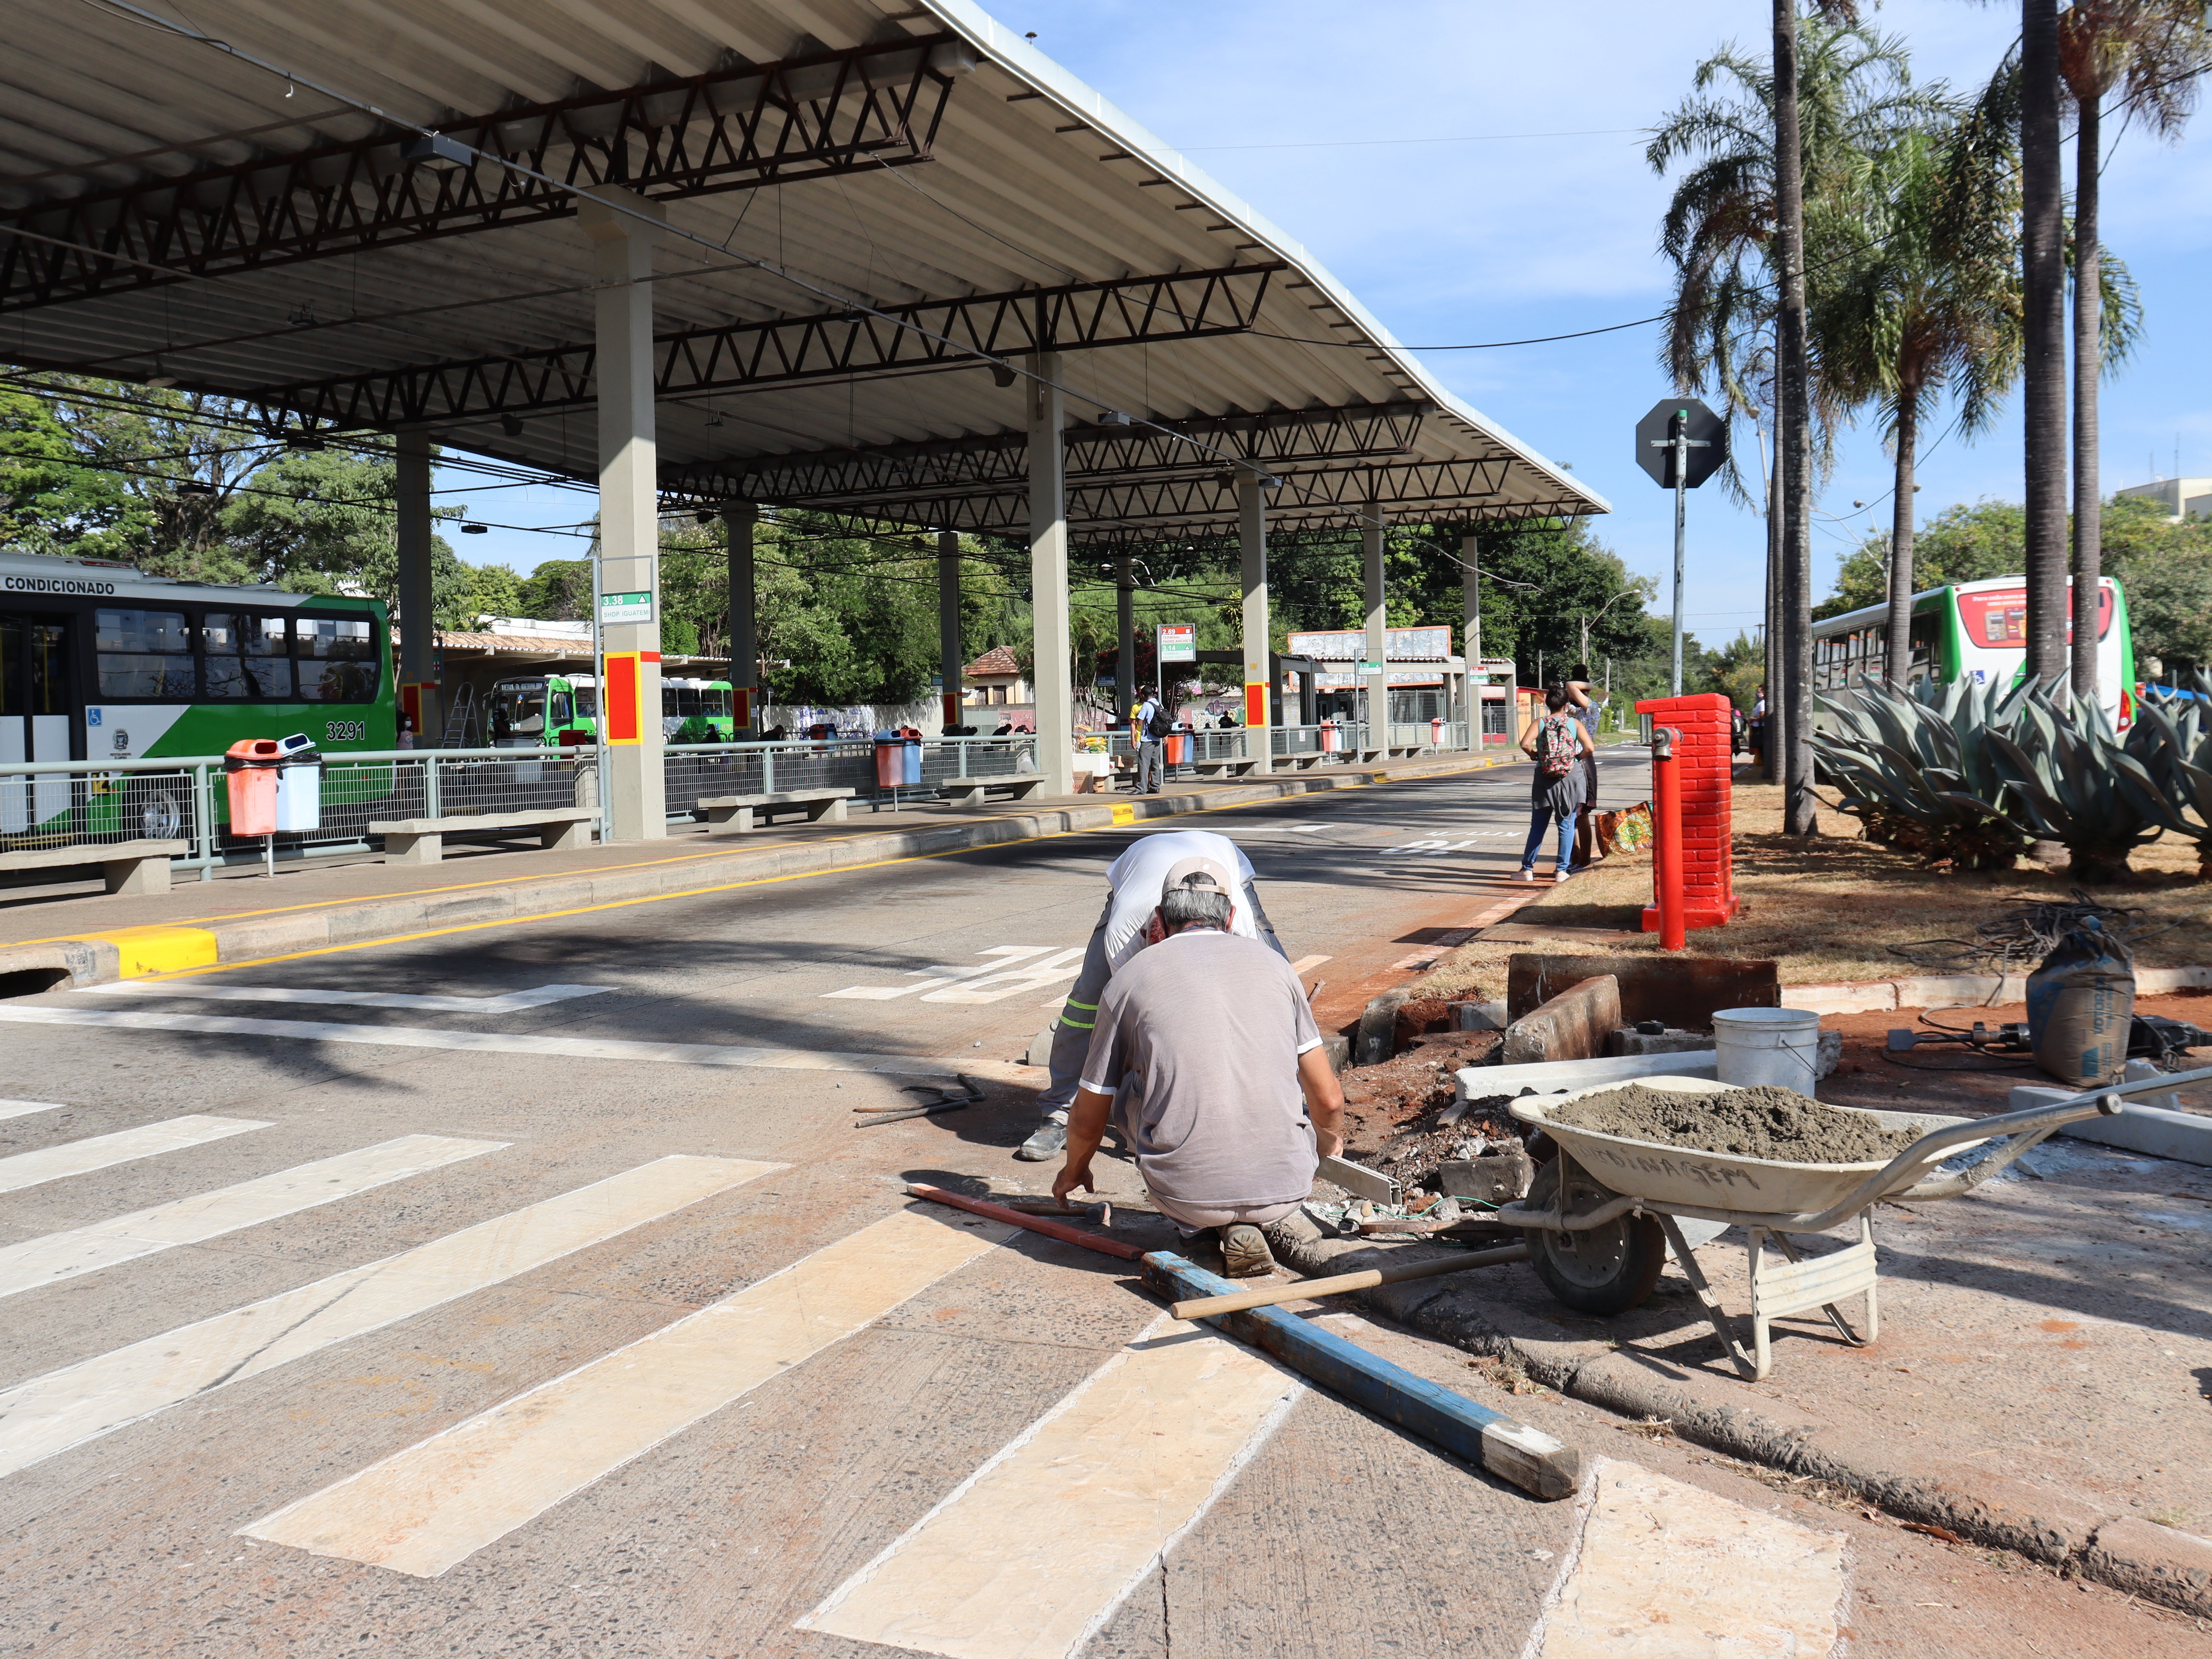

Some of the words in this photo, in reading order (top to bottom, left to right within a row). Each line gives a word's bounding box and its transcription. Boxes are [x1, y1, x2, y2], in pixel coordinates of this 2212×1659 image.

[5, 577, 114, 594] CONDICIONADO
[603, 595, 623, 606] 3.38
[326, 721, 365, 741] 3291
